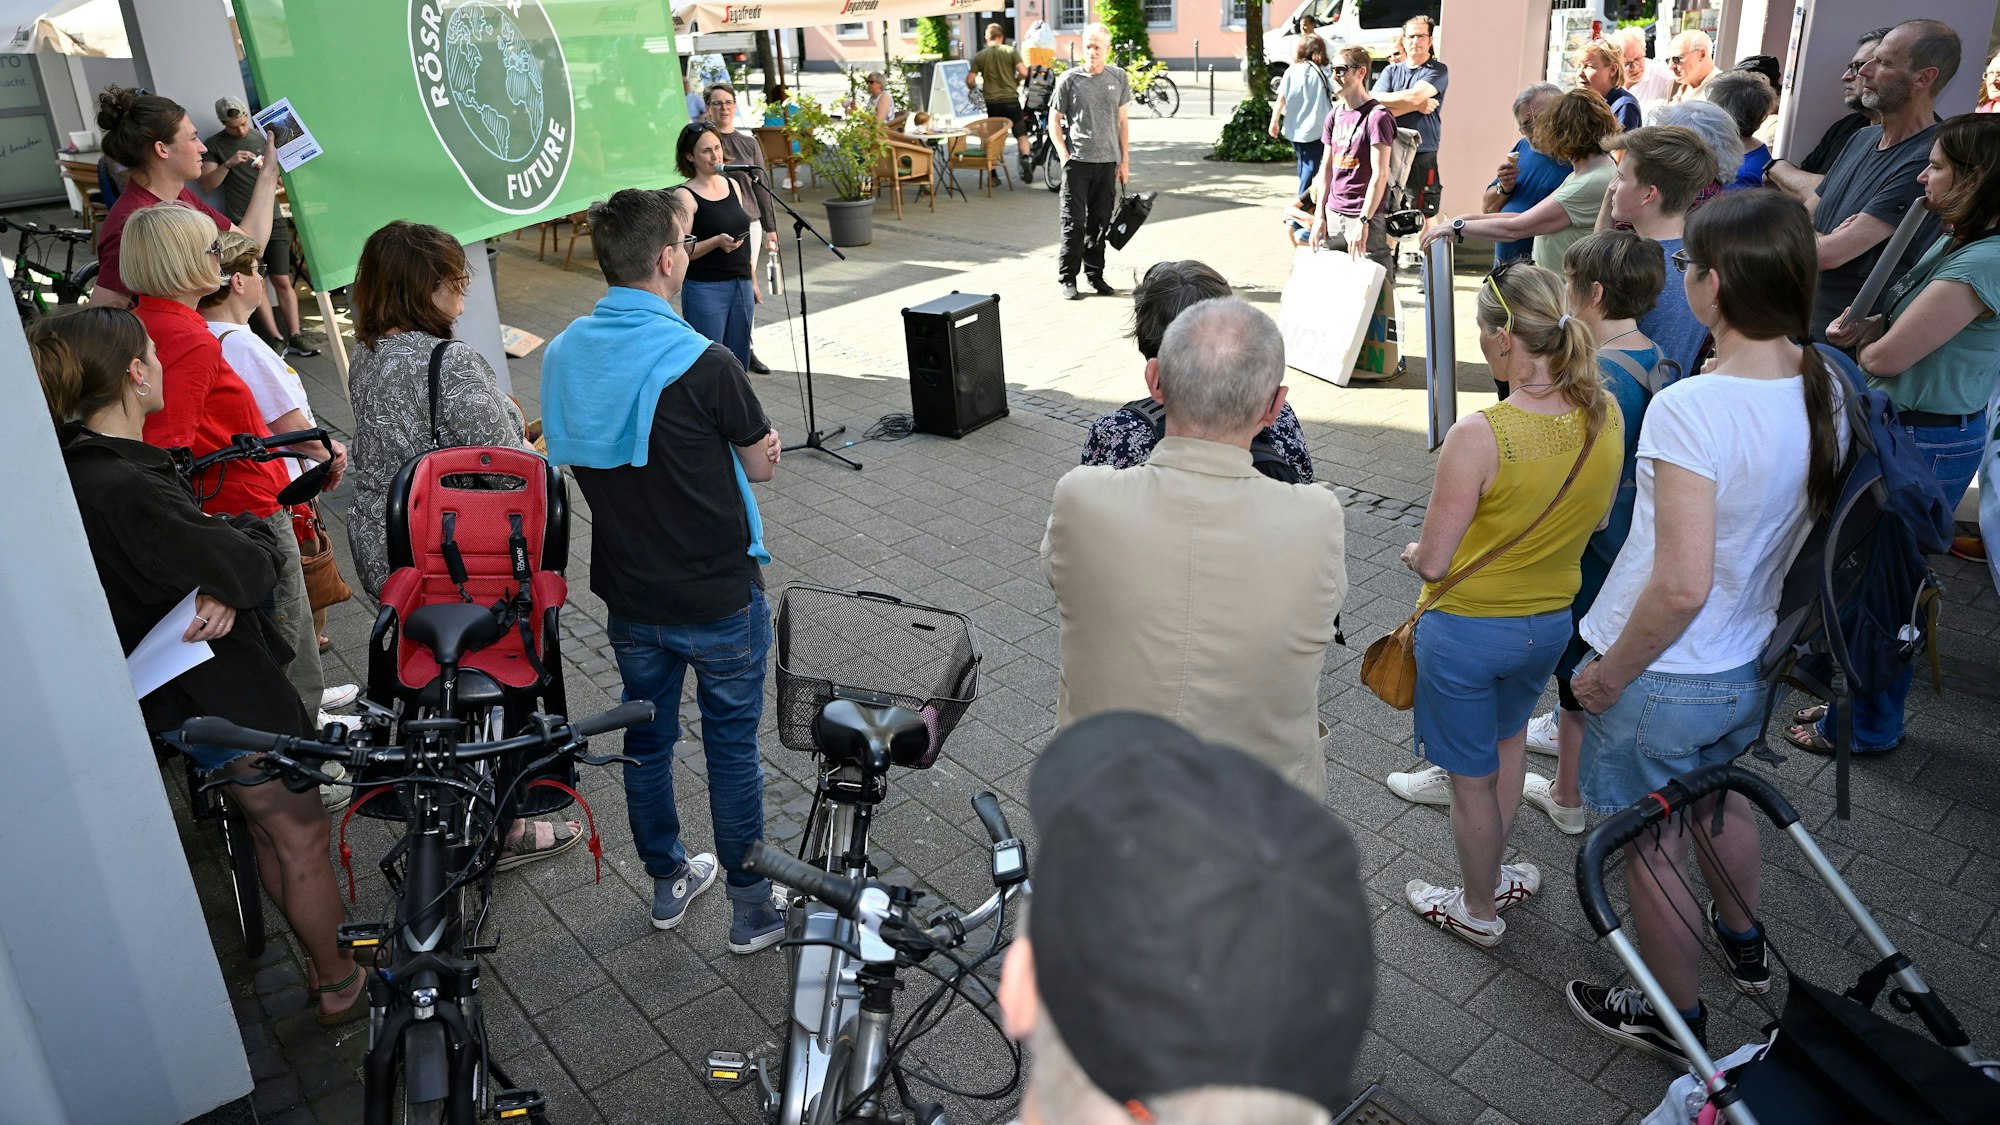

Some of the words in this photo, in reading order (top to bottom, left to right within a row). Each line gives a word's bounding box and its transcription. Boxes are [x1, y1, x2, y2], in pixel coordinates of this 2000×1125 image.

[721, 5, 762, 23] Segafredo
[507, 118, 566, 200] FUTURE
[516, 546, 526, 572] Römer
